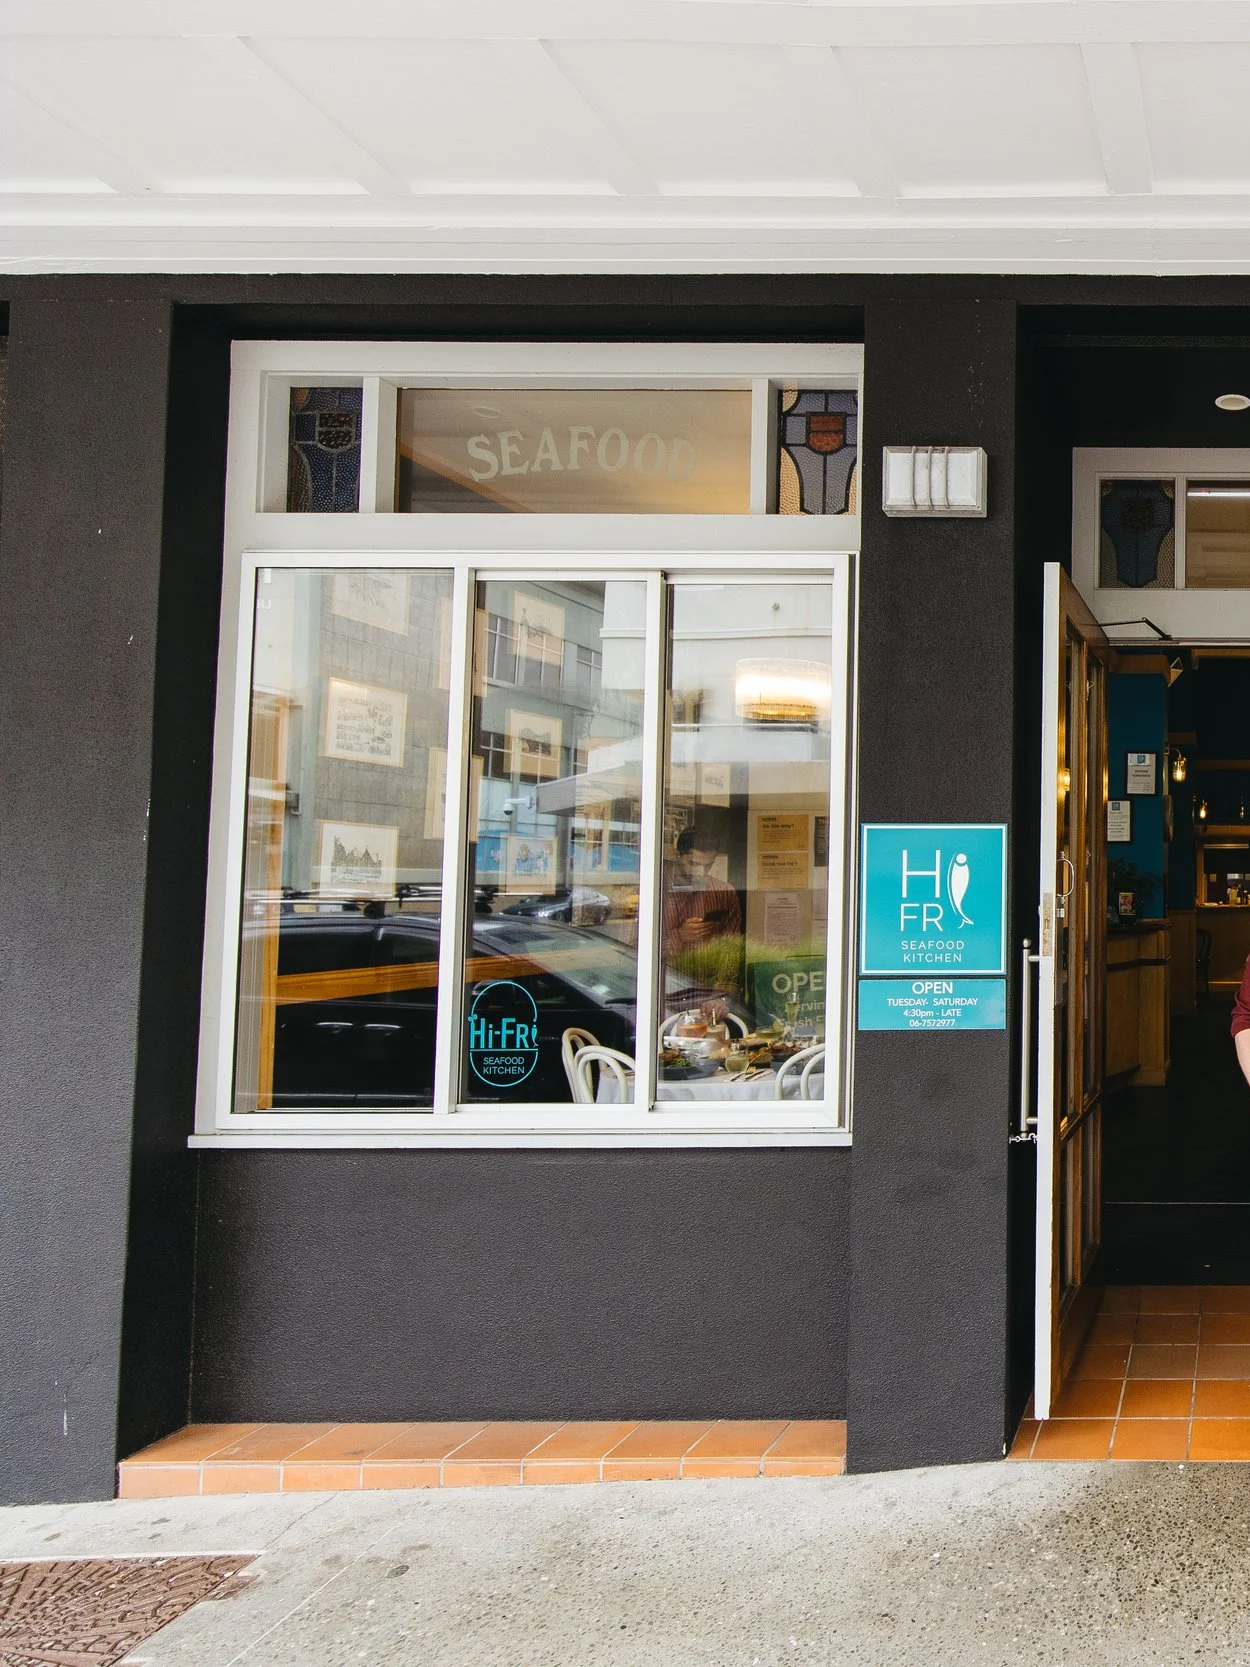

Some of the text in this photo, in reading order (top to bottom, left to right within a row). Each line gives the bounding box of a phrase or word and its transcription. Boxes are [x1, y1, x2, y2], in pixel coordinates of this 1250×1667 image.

[466, 425, 696, 483] SEAFOOD
[901, 940, 965, 950] SEAFOOD
[903, 953, 962, 963] KITCHEN
[772, 971, 825, 993] OPE
[912, 981, 954, 995] OPEN
[933, 998, 979, 1006] SATURDAY
[903, 1009, 934, 1018] 4:30pm
[941, 1008, 962, 1016] LATE
[909, 1018, 956, 1027] 06-7572977
[483, 1056, 525, 1065] SEAFOOD
[483, 1066, 525, 1075] KITCHEN
